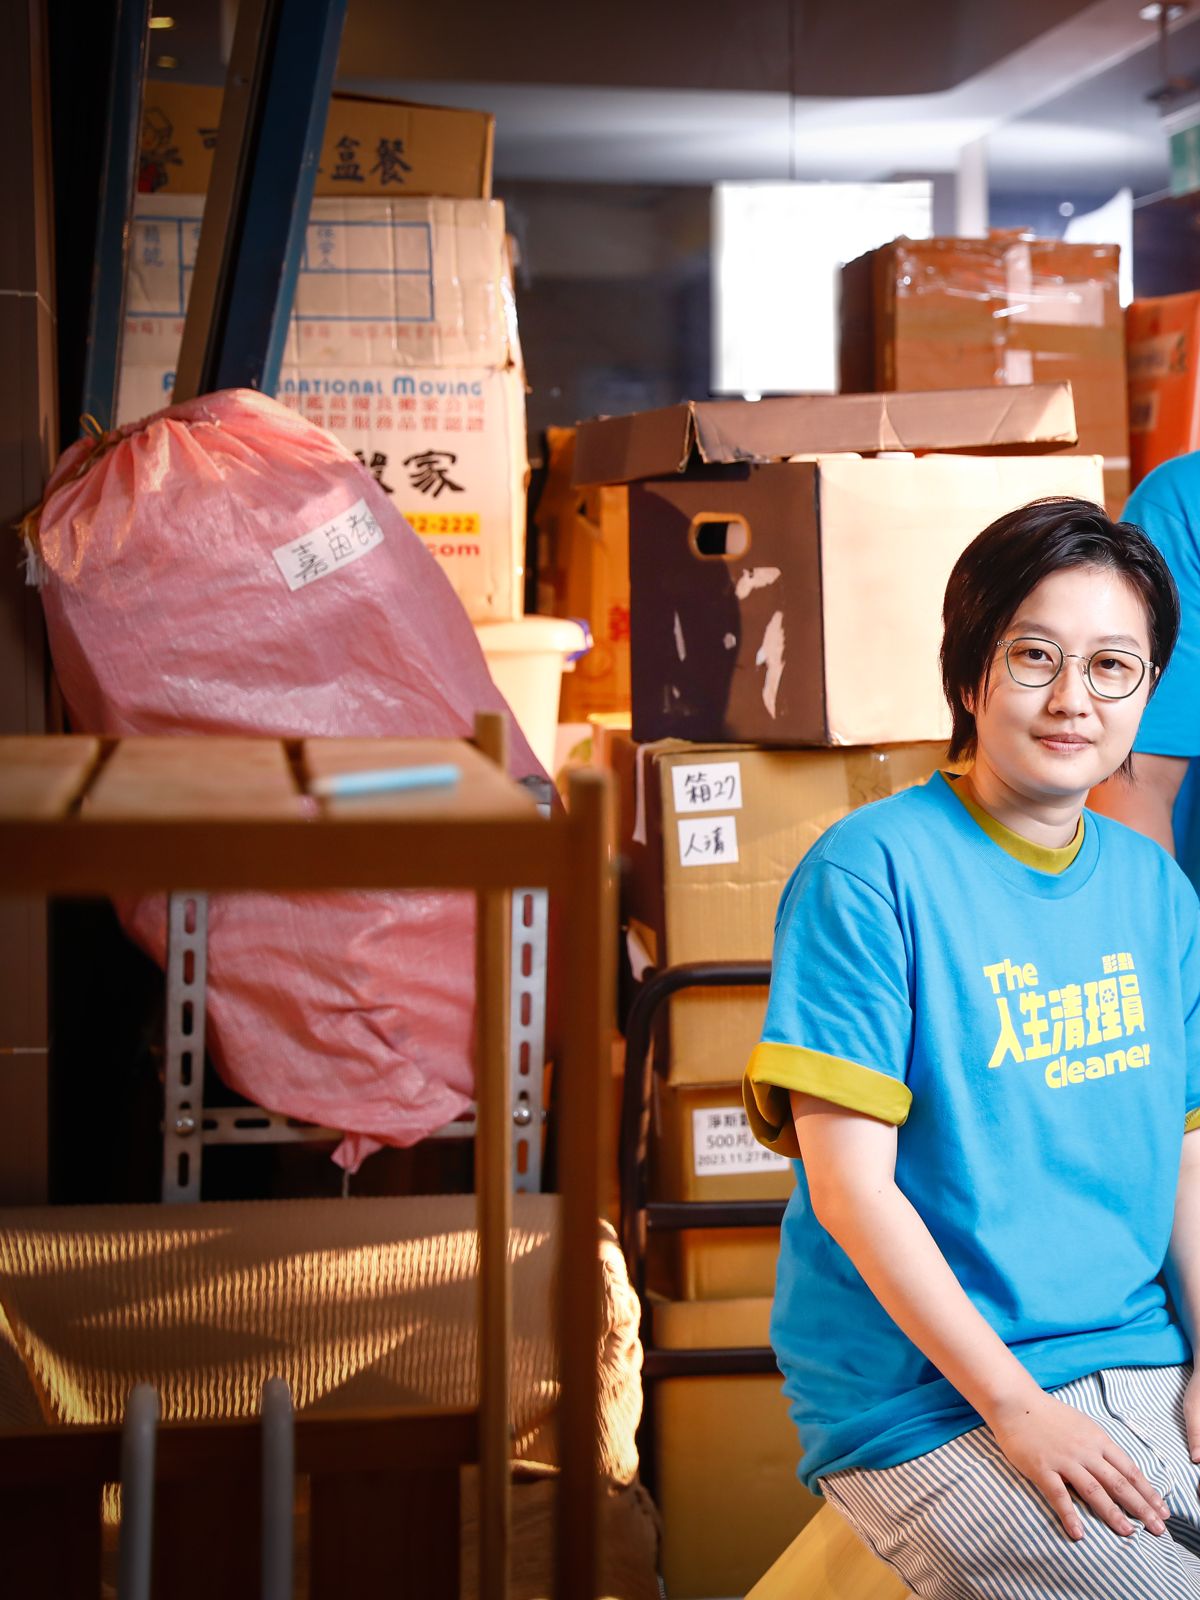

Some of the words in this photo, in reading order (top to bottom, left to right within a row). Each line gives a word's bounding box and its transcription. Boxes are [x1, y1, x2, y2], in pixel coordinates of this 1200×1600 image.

[329, 135, 412, 186] 盒餐
[275, 379, 383, 395] NATIONAL
[684, 772, 735, 804] 箱27
[684, 826, 725, 857] 人清
[983, 958, 1039, 994] The
[988, 974, 1146, 1068] 人生清理員
[1044, 1043, 1151, 1089] Cleaner
